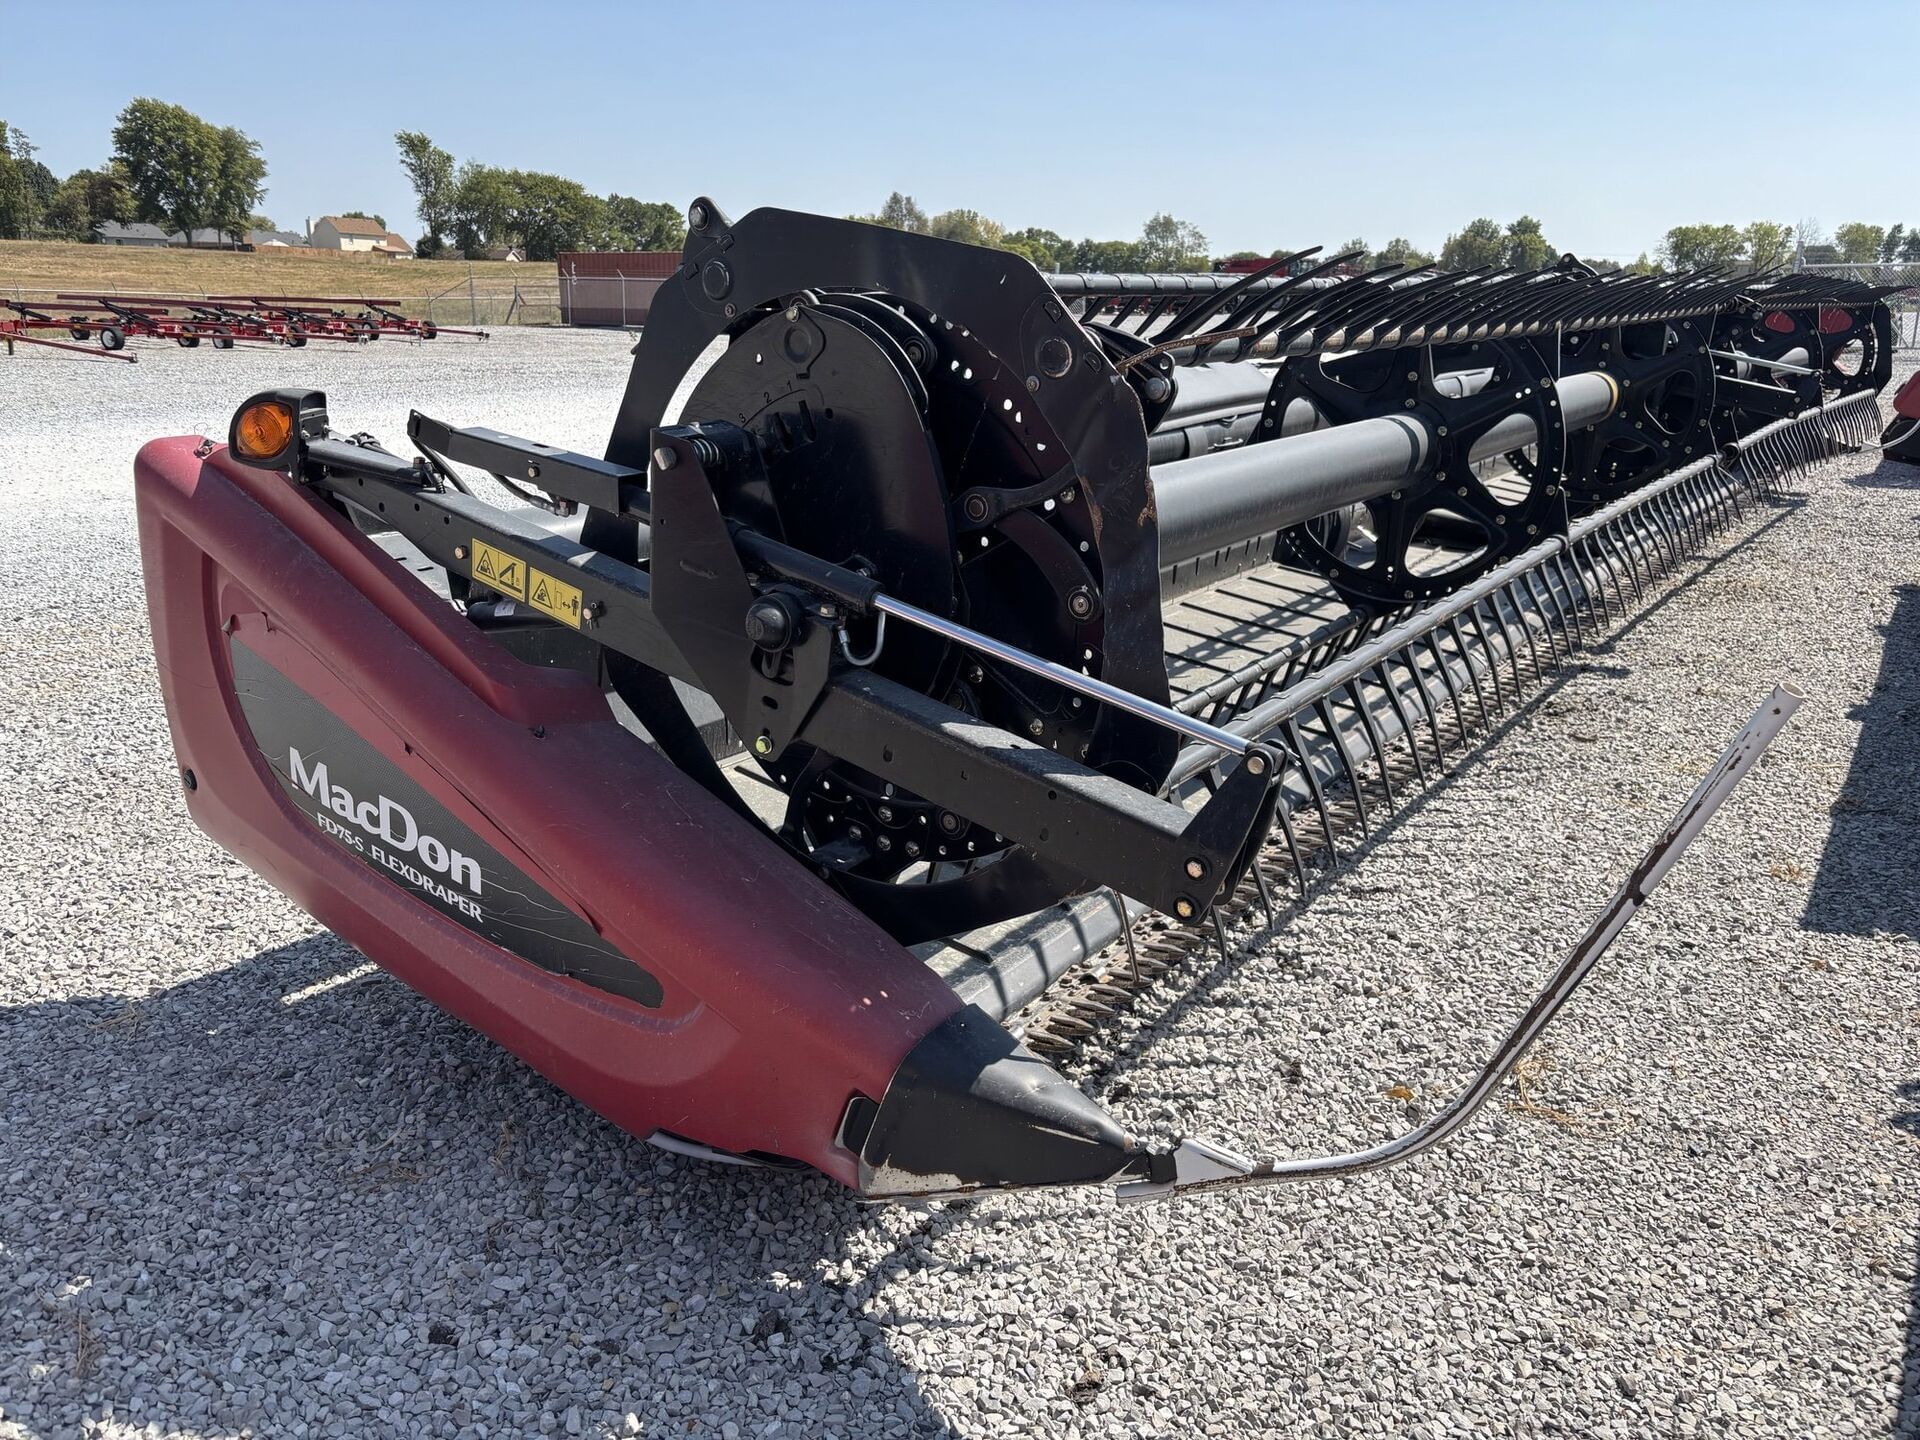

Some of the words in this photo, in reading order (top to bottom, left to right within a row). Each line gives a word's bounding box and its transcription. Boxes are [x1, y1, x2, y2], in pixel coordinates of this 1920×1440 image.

[738, 412, 746, 424] 3
[763, 391, 772, 403] 2
[289, 746, 482, 895] MacDon
[316, 811, 365, 852] FD75-S
[371, 844, 484, 924] FLEXDRAPER
